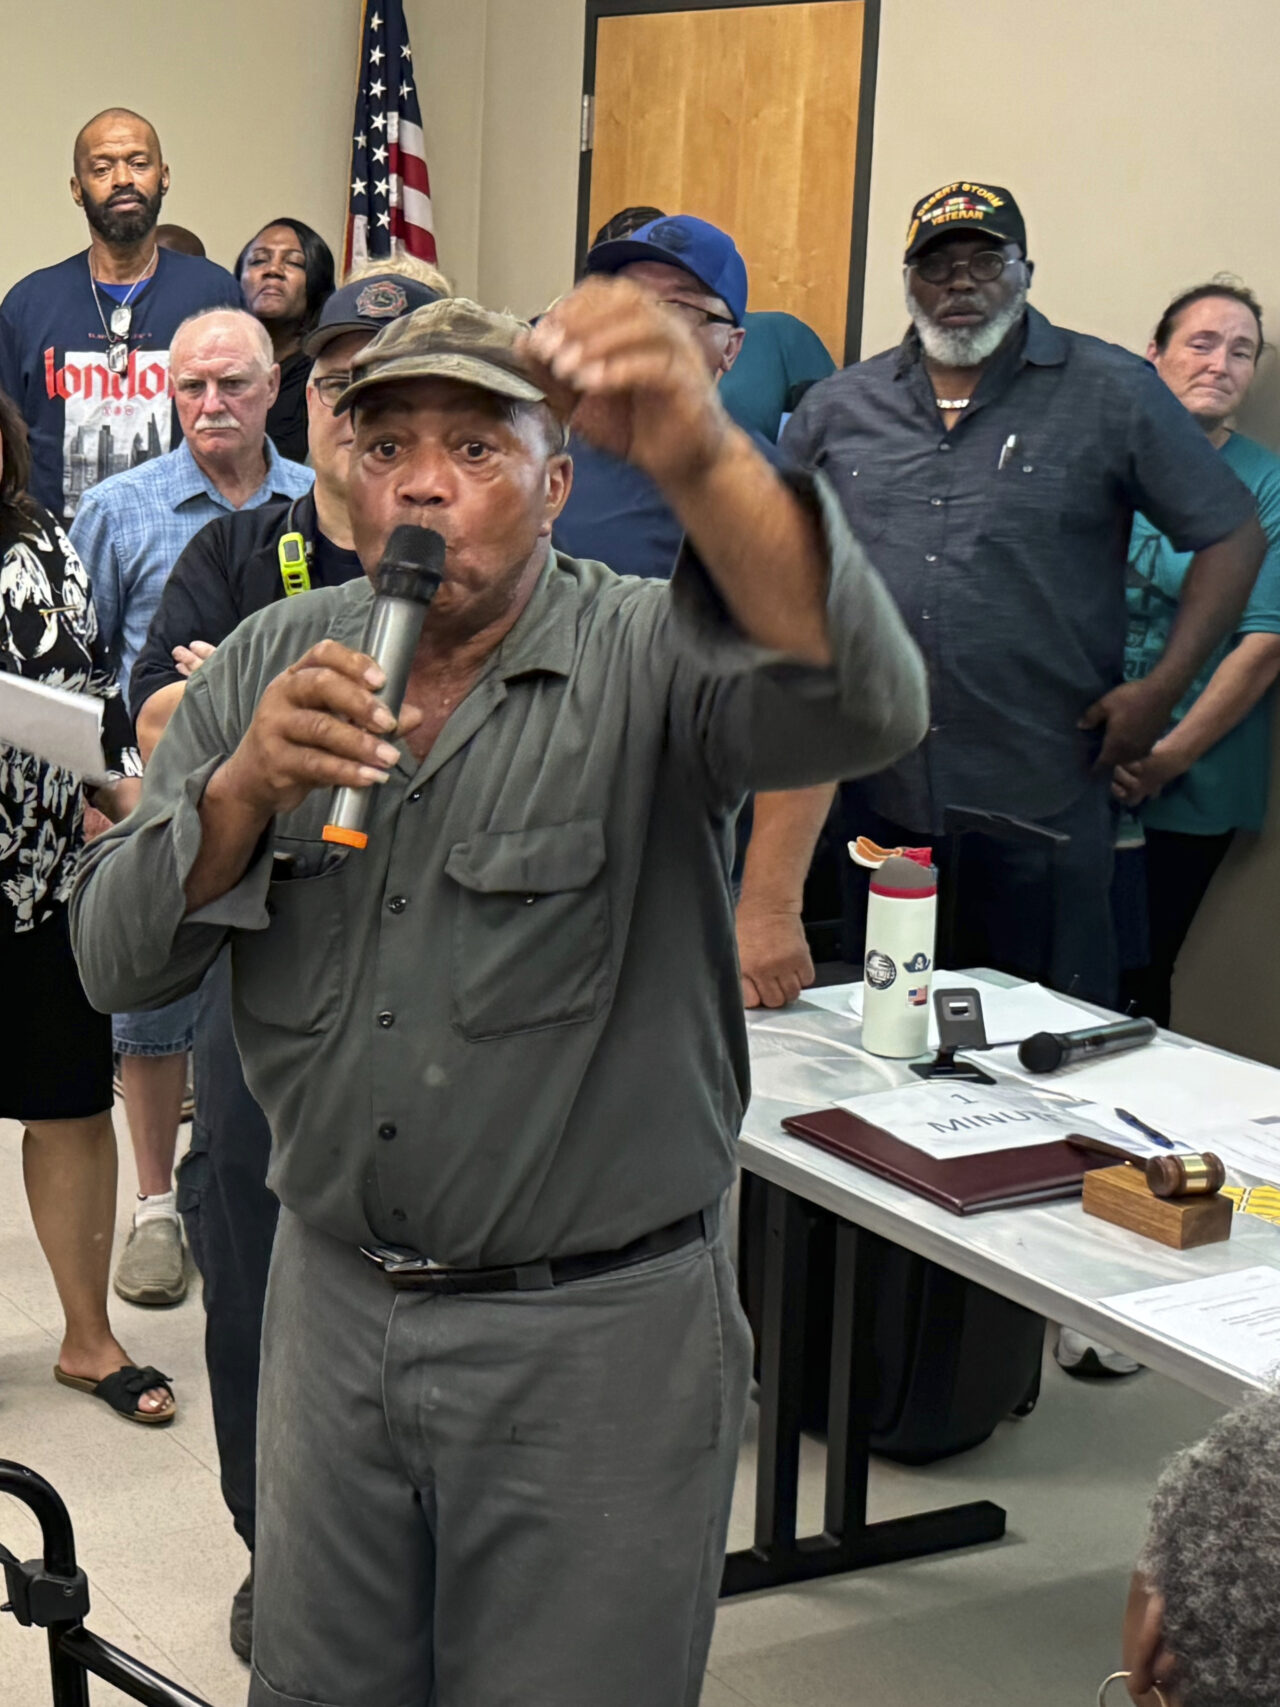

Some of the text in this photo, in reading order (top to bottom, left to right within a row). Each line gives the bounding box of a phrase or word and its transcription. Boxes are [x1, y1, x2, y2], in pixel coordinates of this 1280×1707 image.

[917, 183, 1004, 217] DESERT STORM
[931, 210, 984, 226] VETERAN
[44, 346, 175, 400] londo
[951, 1093, 979, 1105] 1
